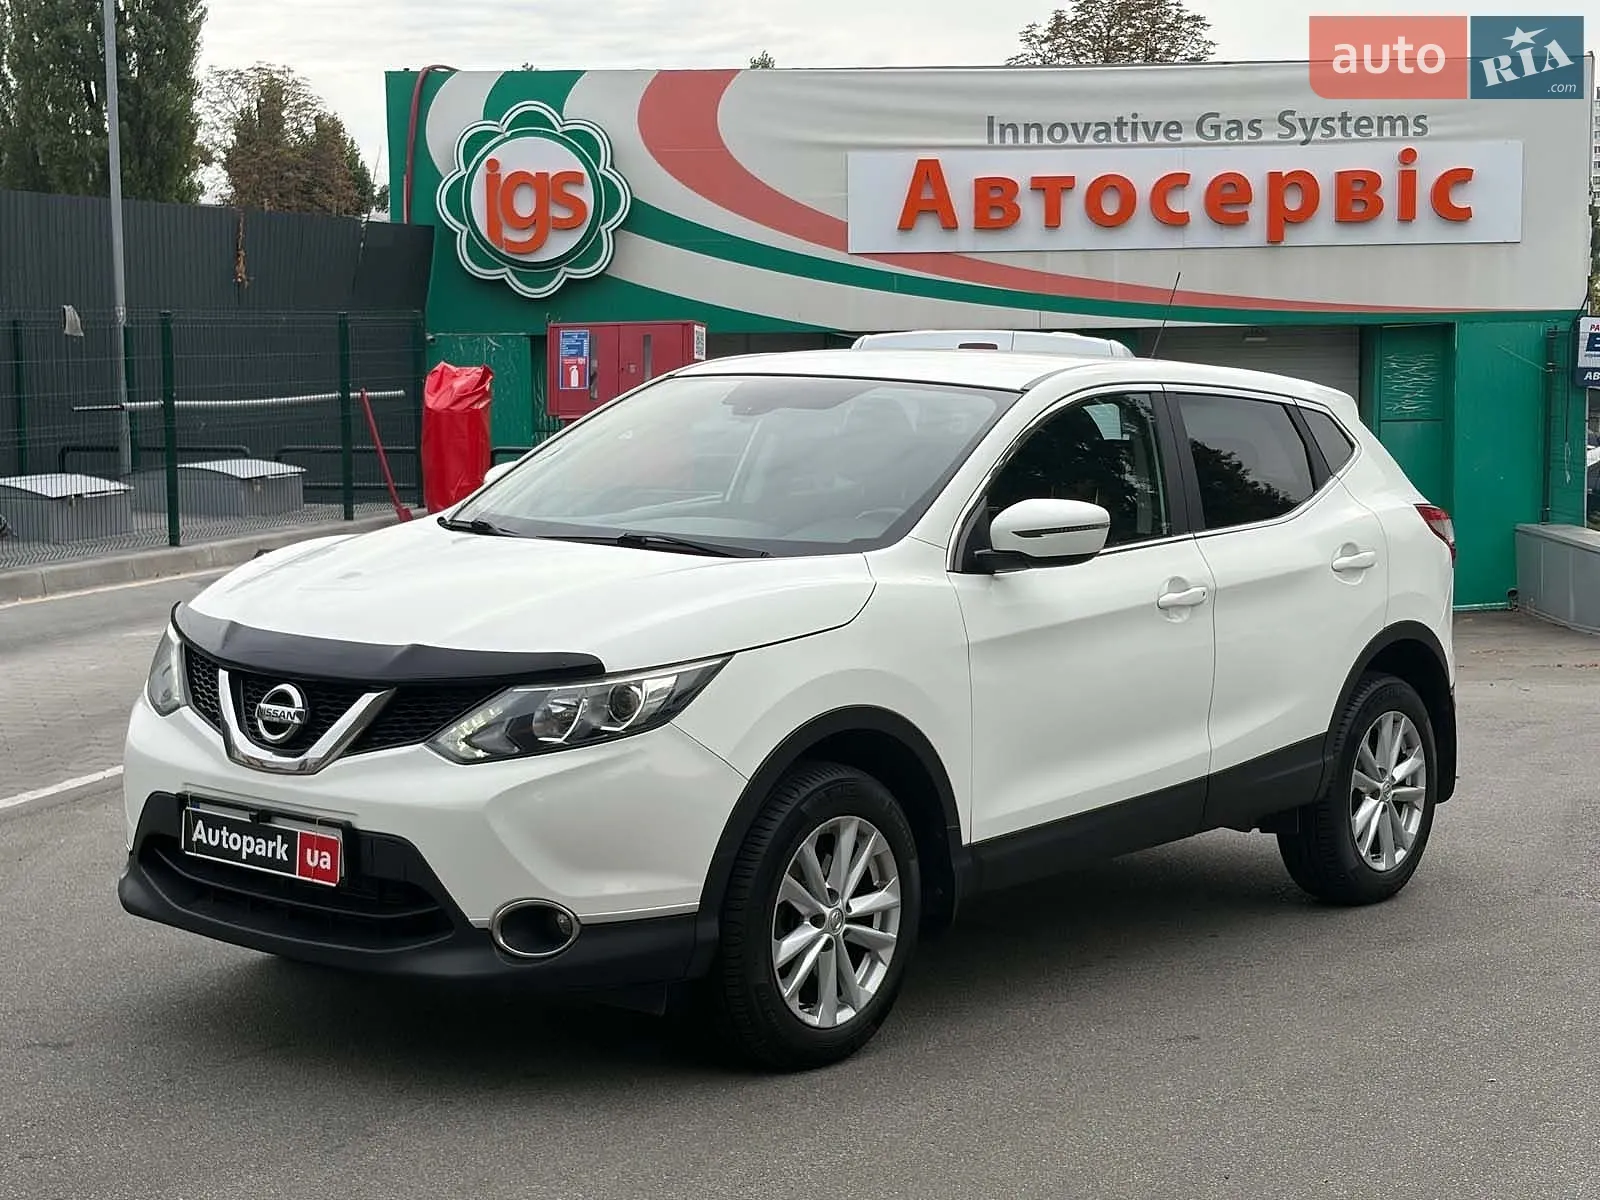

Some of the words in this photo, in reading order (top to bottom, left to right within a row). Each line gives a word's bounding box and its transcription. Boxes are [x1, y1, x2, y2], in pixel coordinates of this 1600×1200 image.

[986, 113, 1184, 145] Innovative
[1196, 111, 1263, 142] Gas
[1277, 109, 1429, 146] Systems
[485, 157, 588, 255] igs
[897, 147, 1475, 243] Автосервіс
[259, 705, 297, 721] NISSAN
[191, 819, 290, 862] Autopark
[306, 846, 332, 871] ua
